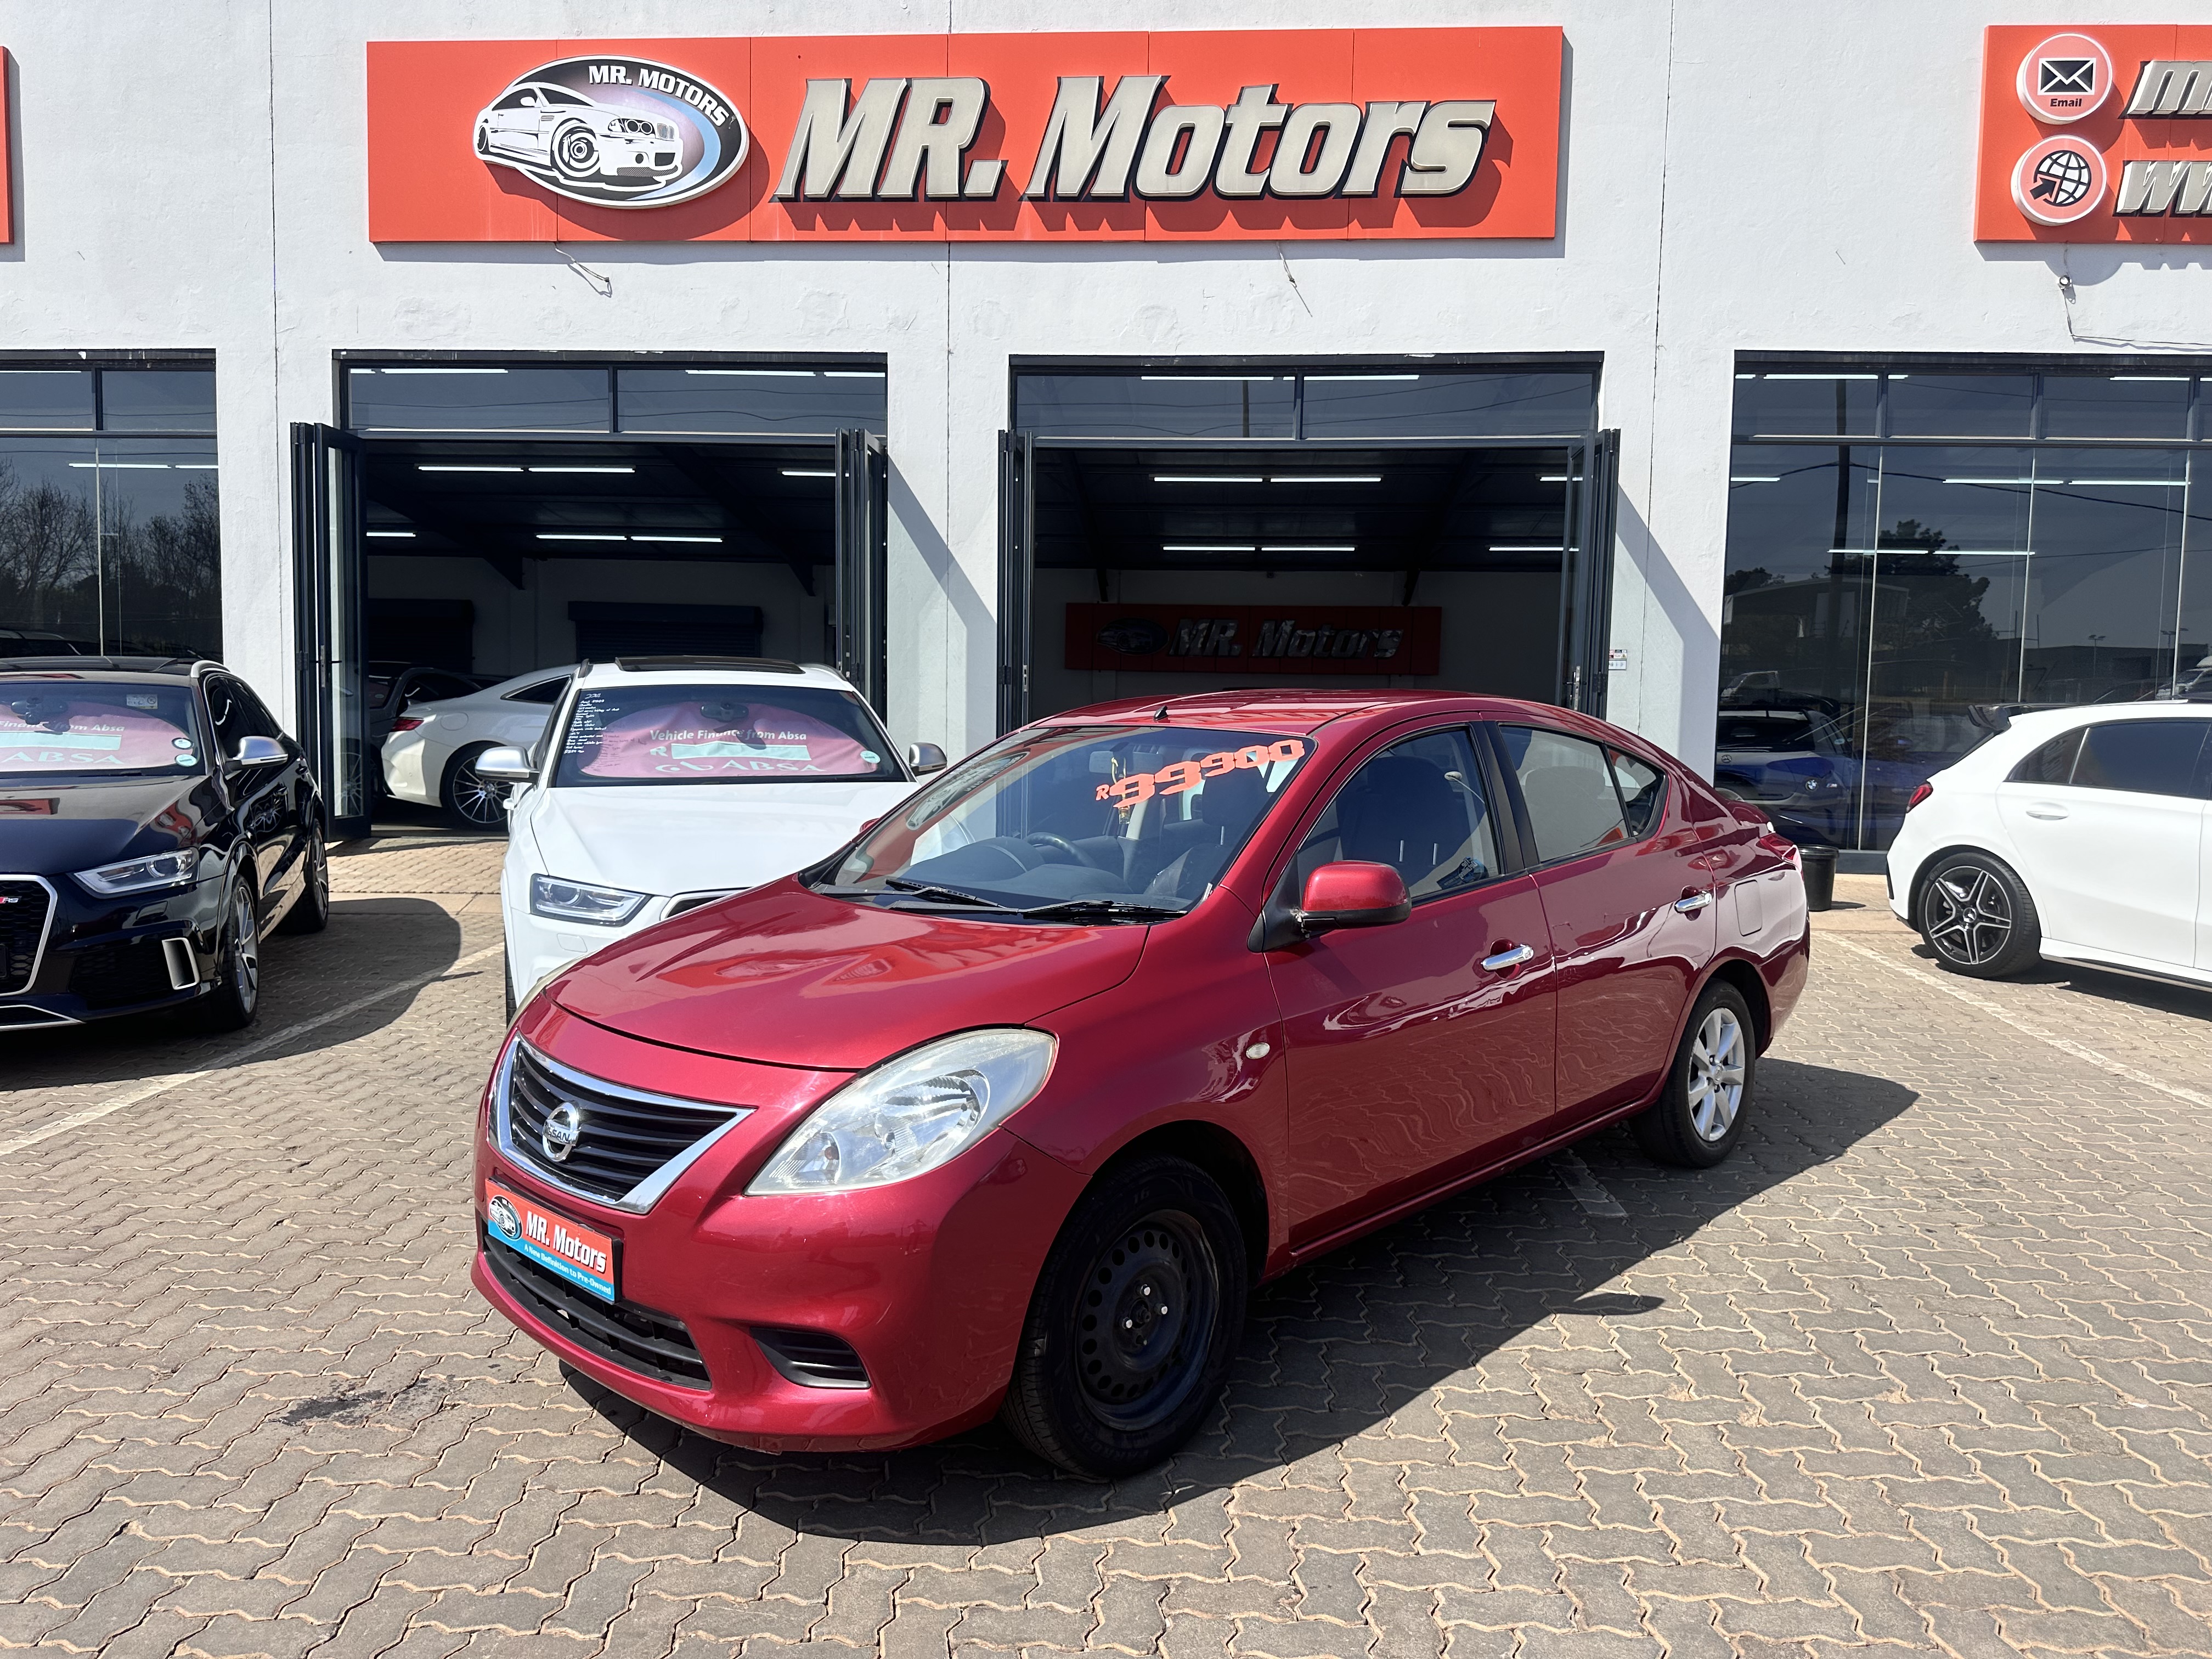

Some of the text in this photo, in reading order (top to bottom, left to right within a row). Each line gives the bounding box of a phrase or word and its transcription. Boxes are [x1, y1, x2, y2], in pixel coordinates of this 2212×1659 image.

[588, 65, 730, 127] MR. MOTORS
[2126, 60, 2211, 114] m
[2050, 98, 2083, 108] Email
[774, 75, 1494, 200] MR. Motors
[1170, 619, 1404, 658] MR. Motors
[650, 730, 693, 741] Vehicle
[744, 729, 775, 740] from
[778, 731, 807, 740] Absa
[1, 751, 125, 764] ABSA
[650, 746, 668, 757] R
[722, 759, 827, 772] ABSA
[544, 1122, 571, 1142] SSAN
[526, 1210, 607, 1273] MR. Motors
[524, 1244, 612, 1295] A New Definition to Pre-Owned
